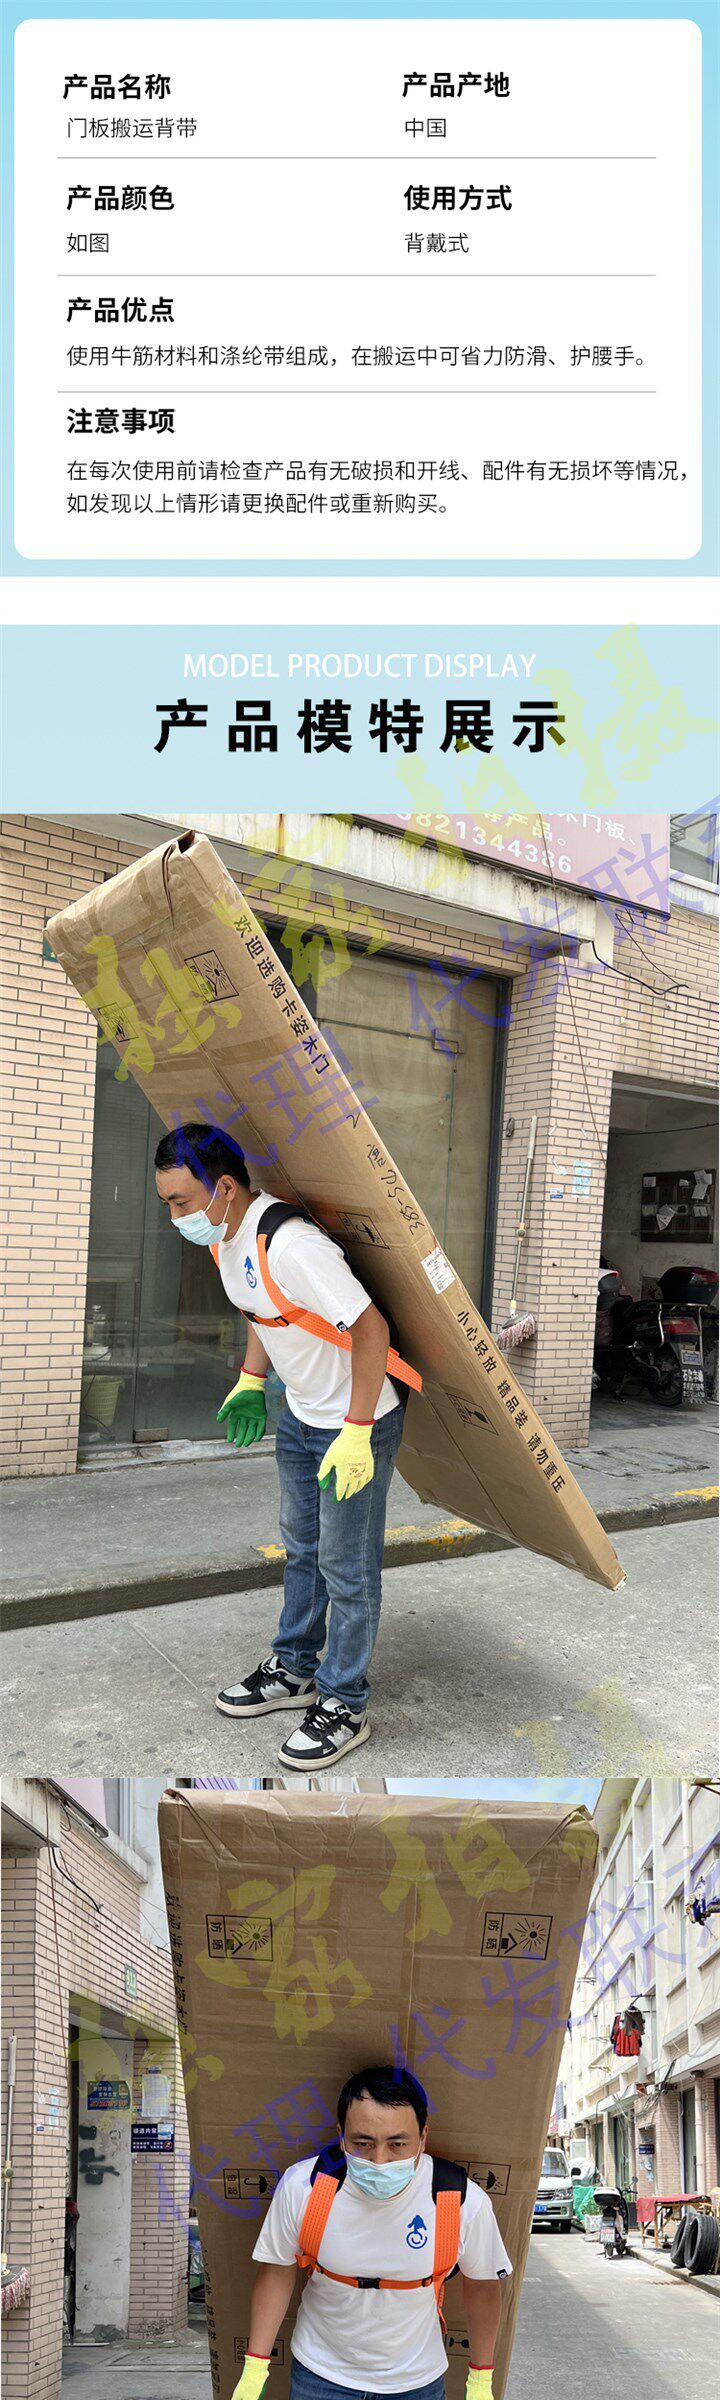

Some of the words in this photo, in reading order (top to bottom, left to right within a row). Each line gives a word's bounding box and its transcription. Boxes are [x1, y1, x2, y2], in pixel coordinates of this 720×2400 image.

[457, 1309, 497, 1375] 小心轻放
[496, 1379, 530, 1429] 精品装
[527, 1432, 566, 1494] 请勿重压
